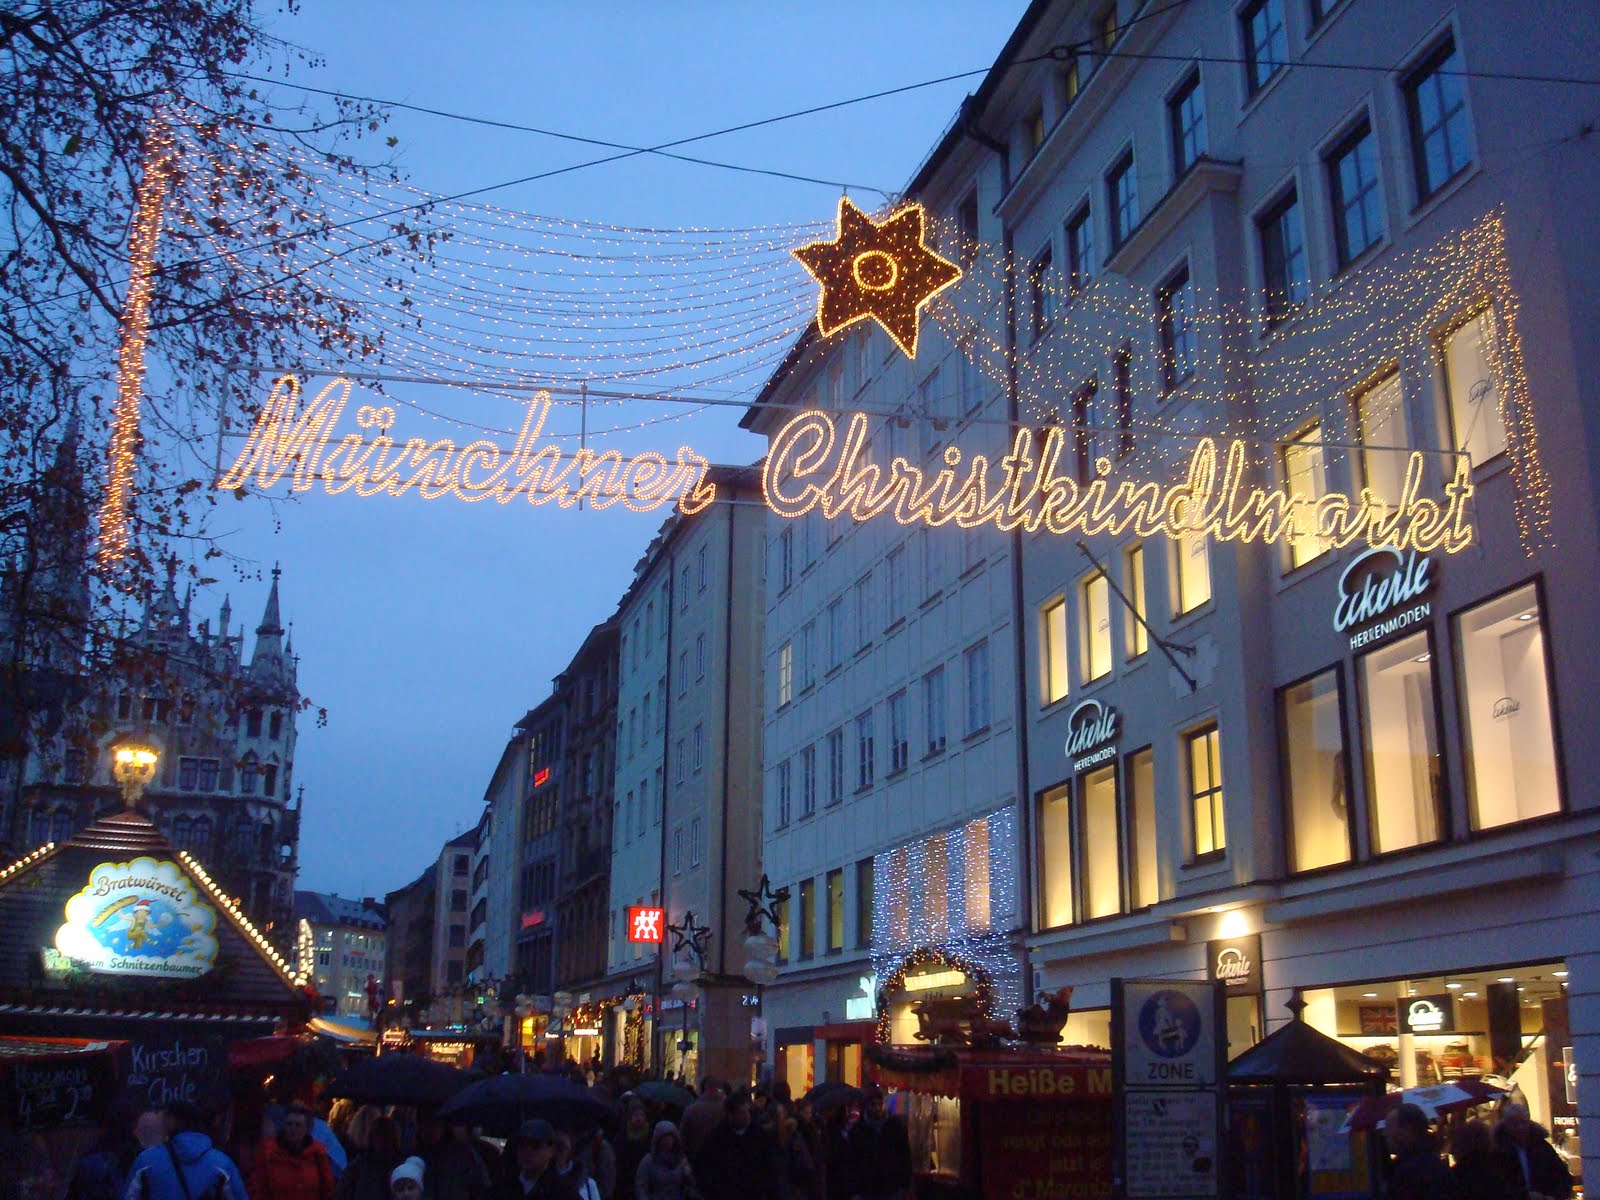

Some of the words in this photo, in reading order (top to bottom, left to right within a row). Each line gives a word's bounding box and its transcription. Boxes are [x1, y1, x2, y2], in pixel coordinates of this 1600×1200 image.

[217, 374, 716, 515] Münchner
[761, 409, 1476, 554] Christkindlmarkt
[1333, 545, 1430, 632] Eckerle
[1350, 602, 1430, 650] HERRENMODEN
[1065, 699, 1116, 758] Eckerle
[1074, 745, 1117, 771] HERRENMODEN
[93, 876, 187, 902] Bratwürstl
[109, 957, 203, 973] Schnitzenbaumer
[1216, 947, 1250, 979] Eckerle
[131, 1040, 208, 1072] Kirschen
[1147, 1063, 1194, 1079] ZONE
[148, 1072, 197, 1104] Chile
[987, 1069, 1075, 1095] Heiße
